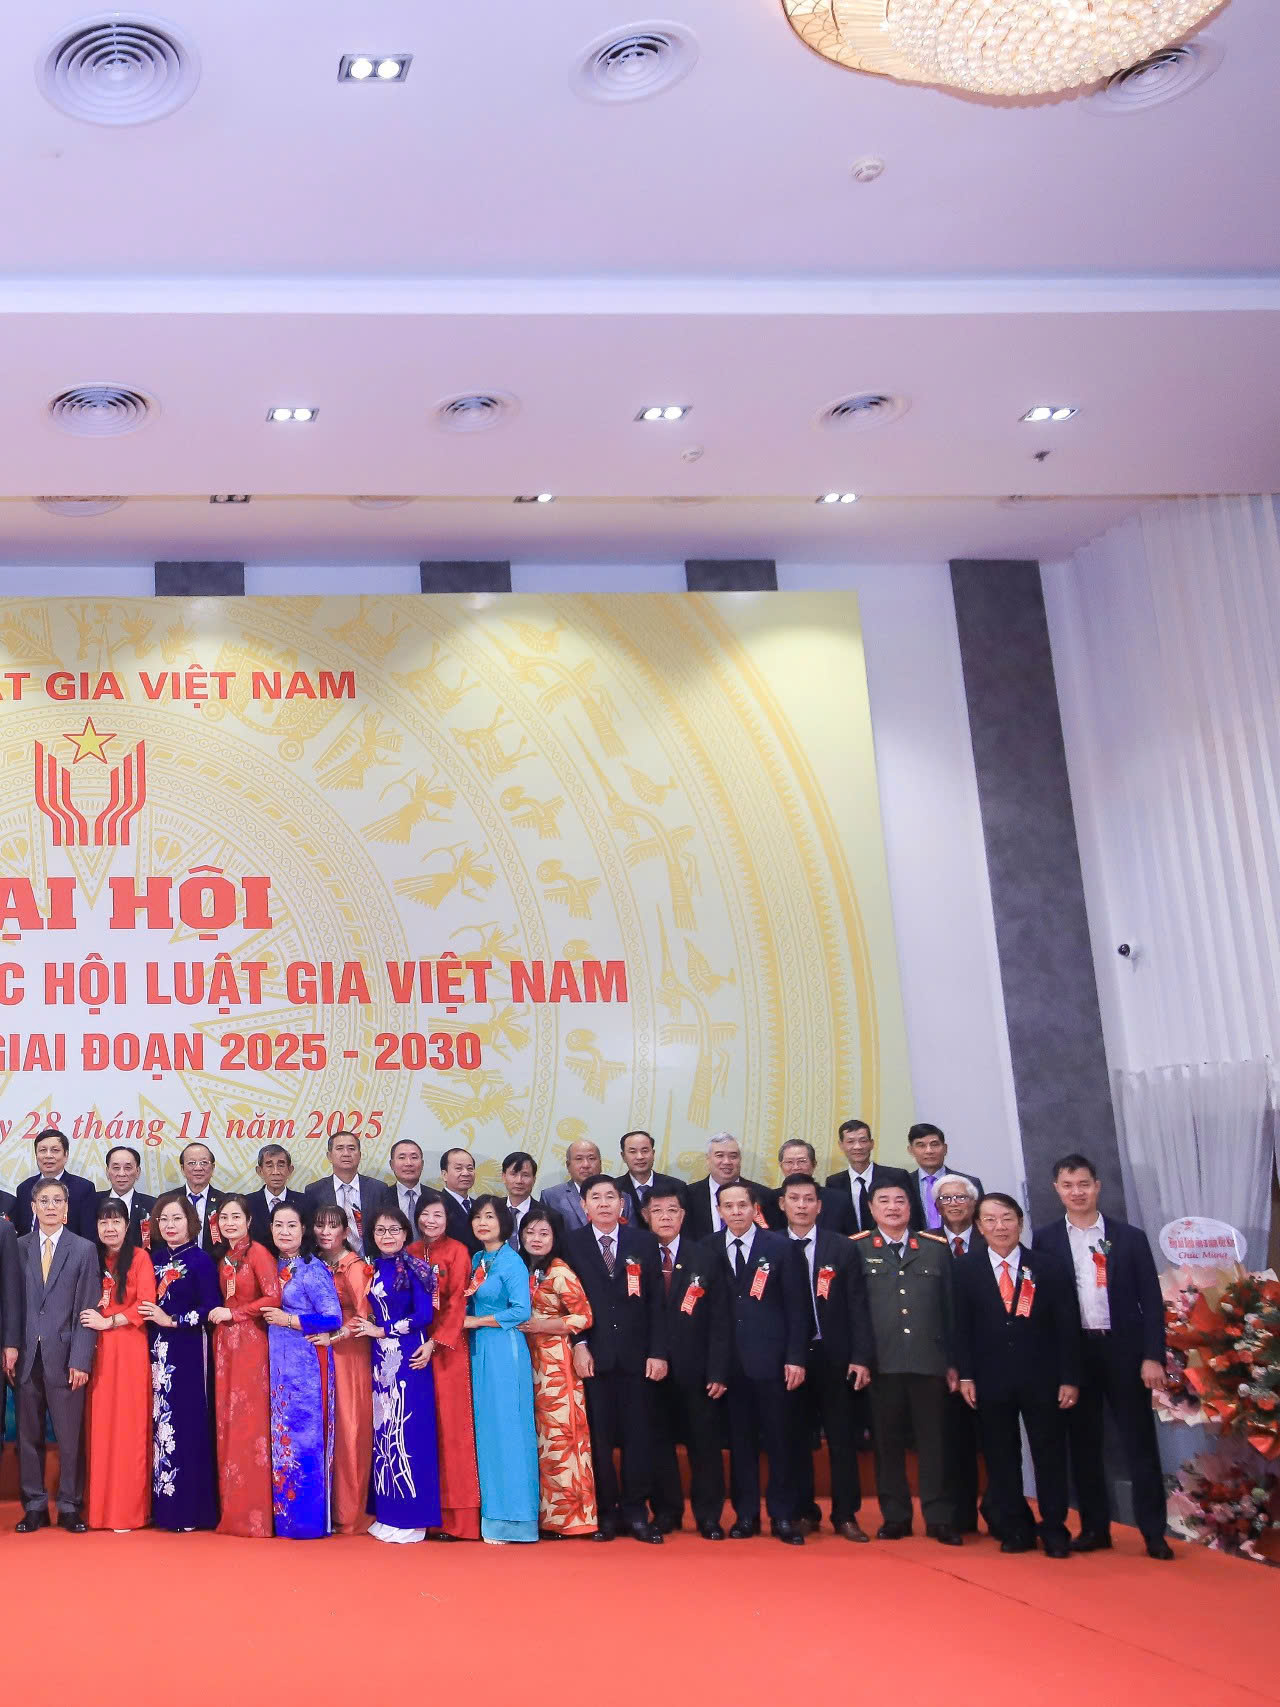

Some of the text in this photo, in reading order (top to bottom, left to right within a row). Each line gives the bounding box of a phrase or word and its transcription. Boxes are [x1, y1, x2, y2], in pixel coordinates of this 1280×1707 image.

[45, 671, 124, 701] GIA
[138, 663, 237, 709] VIỆT
[252, 671, 356, 700] NAM
[108, 865, 273, 941] HỘI
[44, 952, 127, 1015] HỘI
[146, 951, 269, 1015] LUẬT
[285, 960, 372, 1005] GIA
[385, 951, 494, 1013] VIỆT
[510, 959, 629, 1004] NAM
[80, 1032, 205, 1081] ĐOẠN
[219, 1032, 328, 1071] 2025
[343, 1049, 359, 1059] -
[374, 1031, 482, 1071] 2030
[22, 1111, 62, 1139] 28
[72, 1110, 166, 1146] tháng
[176, 1111, 211, 1139] 11
[225, 1114, 296, 1139] năm
[305, 1110, 384, 1139] 2025
